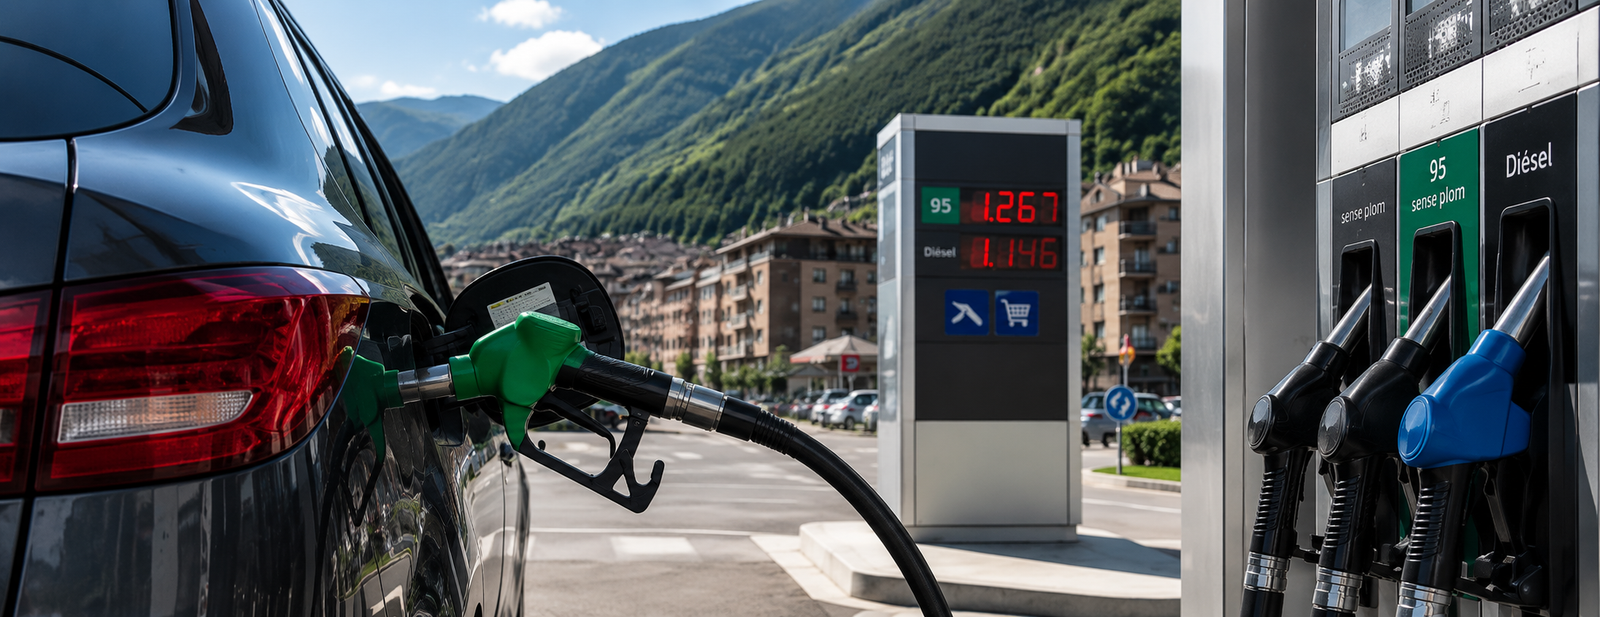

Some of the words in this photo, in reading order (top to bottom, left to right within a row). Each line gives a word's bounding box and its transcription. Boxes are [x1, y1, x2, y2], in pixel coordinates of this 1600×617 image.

[1429, 156, 1447, 183] 95
[1506, 142, 1553, 178] Diésel
[930, 197, 952, 214] 95
[984, 190, 1059, 223] 1.267
[1411, 194, 1437, 212] sense
[1439, 185, 1465, 209] plom
[1341, 207, 1363, 224] sense
[1364, 201, 1386, 221] plom
[924, 246, 957, 258] Diésel
[983, 237, 1057, 269] 1.146
